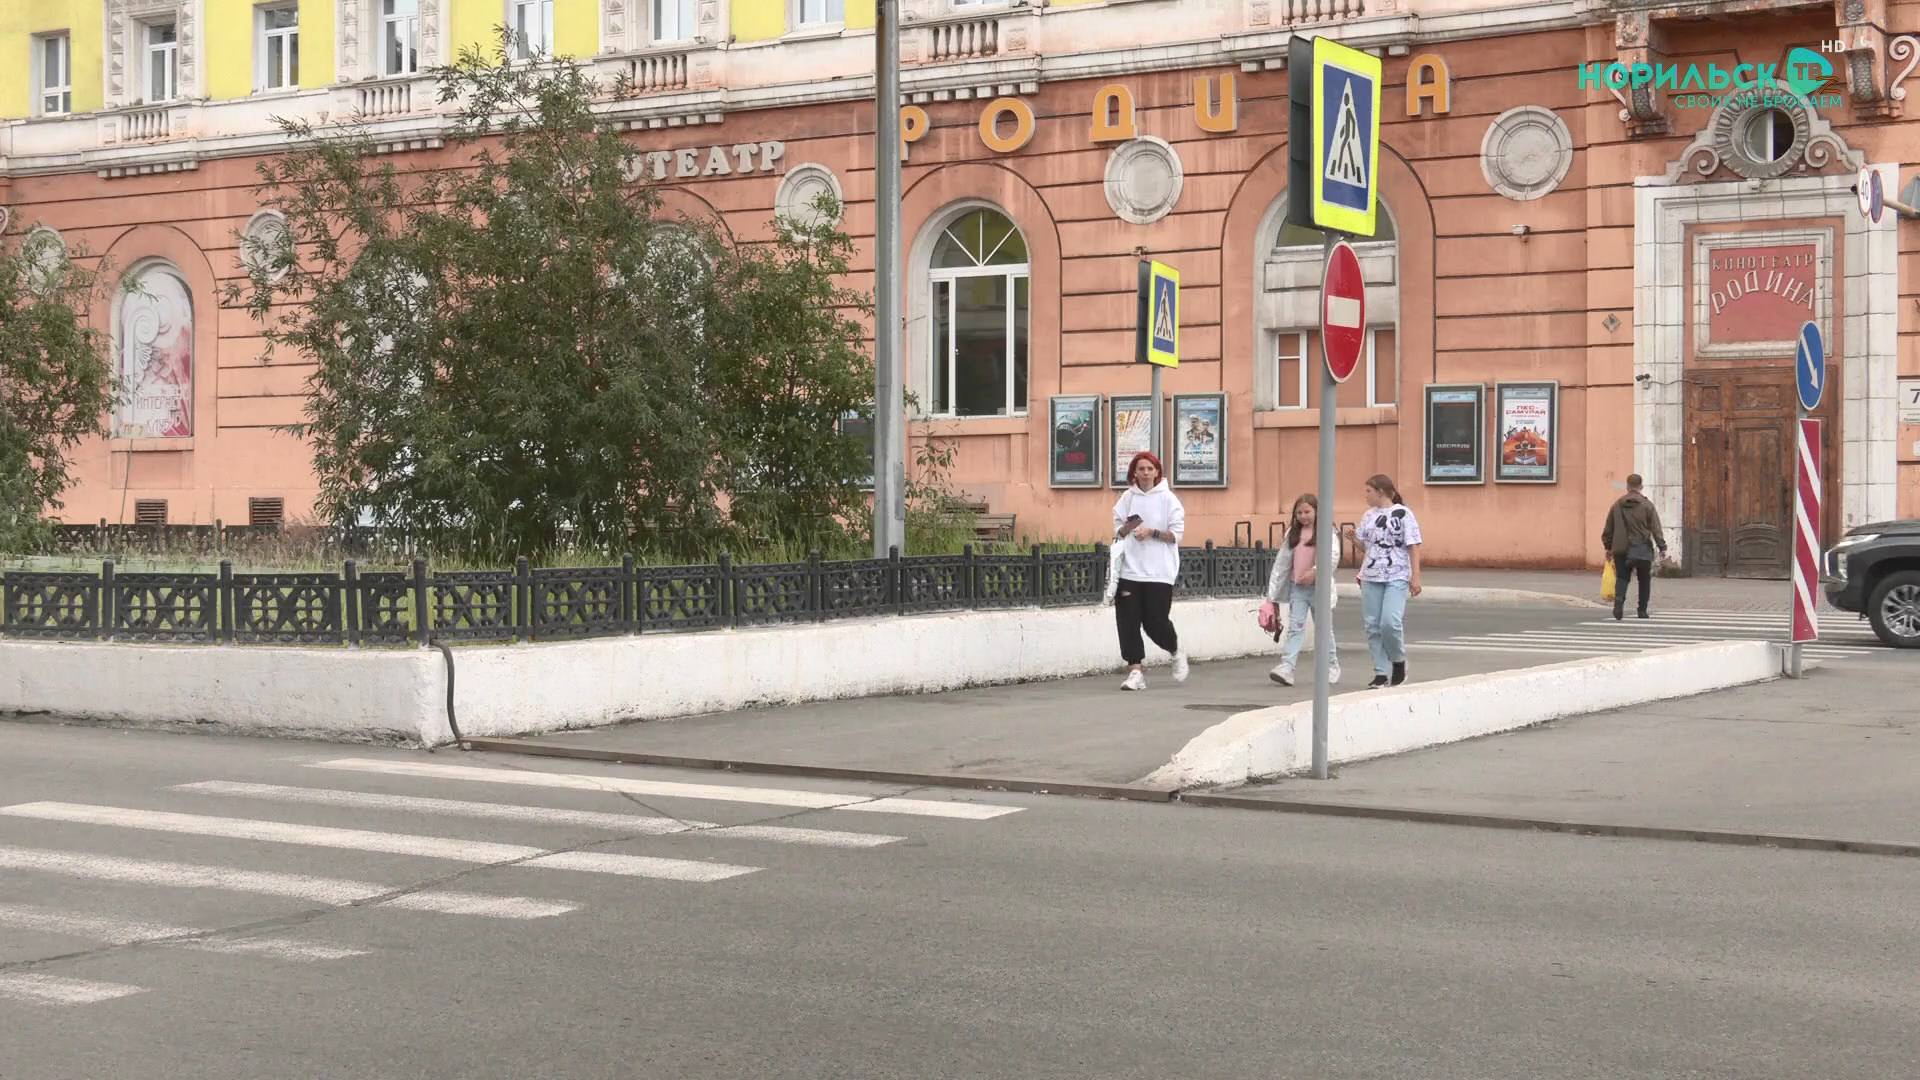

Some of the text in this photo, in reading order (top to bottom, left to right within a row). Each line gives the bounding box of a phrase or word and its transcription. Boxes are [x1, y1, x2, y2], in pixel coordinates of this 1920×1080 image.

[900, 54, 1451, 161] РОДИА
[1861, 180, 1869, 200] 40
[1712, 254, 1813, 271] КИНОТЕАТР
[1711, 270, 1814, 314] РОДИНА
